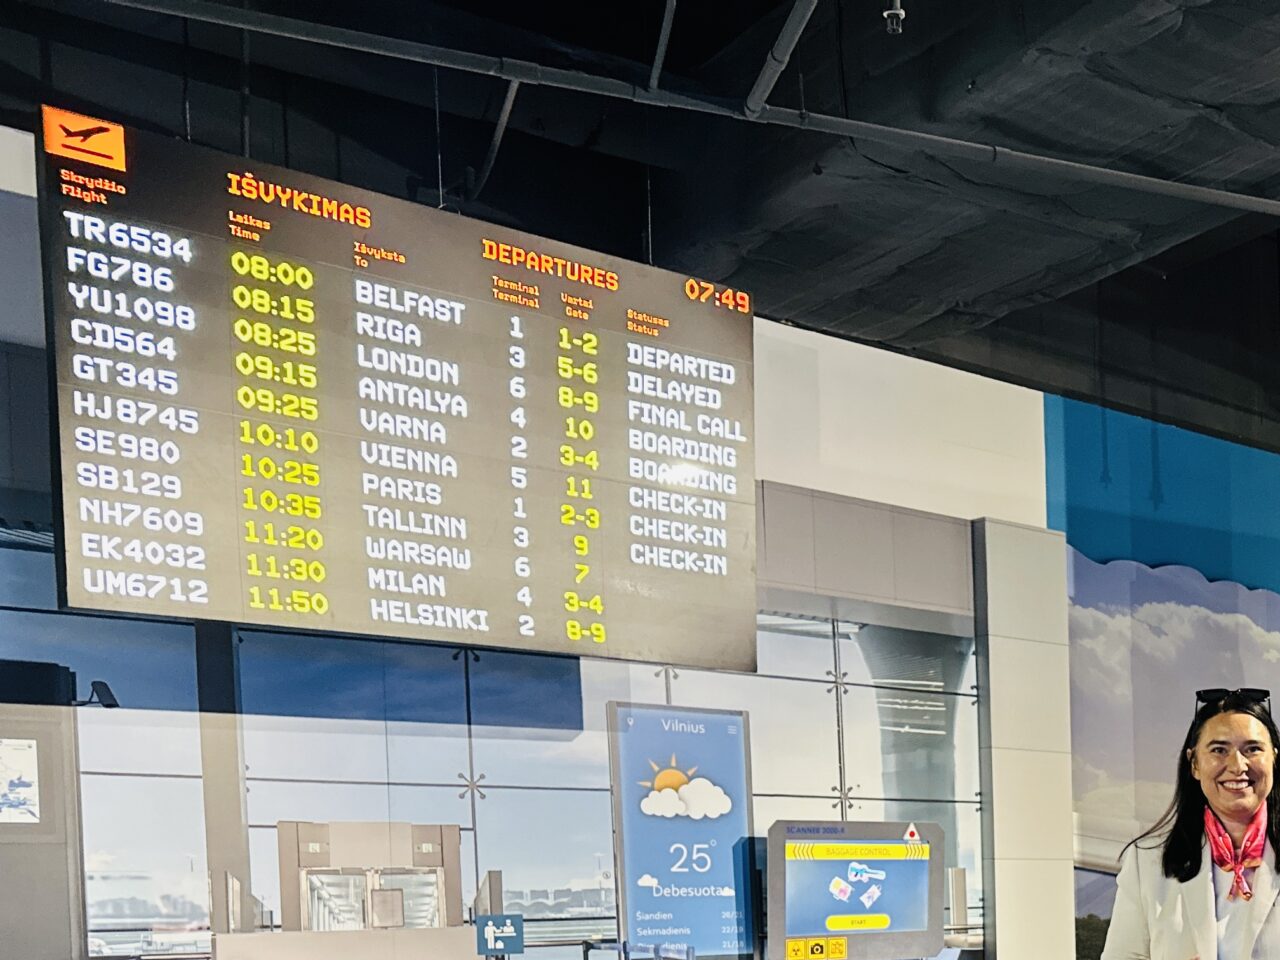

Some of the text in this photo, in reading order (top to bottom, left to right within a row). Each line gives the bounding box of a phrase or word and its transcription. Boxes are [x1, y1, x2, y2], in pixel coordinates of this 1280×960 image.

[61, 168, 126, 195] Skrydžio
[61, 184, 107, 204] Flight
[226, 171, 372, 229] IŠVYKIMAS
[228, 210, 271, 230] Laikas
[228, 225, 260, 242] Time
[353, 255, 369, 269] To
[482, 238, 751, 314] DEPARTURES 07:49
[492, 275, 541, 296] Terminal
[62, 210, 735, 385] TR6534 08:00 BELFAST 1 1-2 DEPARTED
[66, 246, 722, 410] FG786 08:15 RIGA 3 5-6 DELAYED
[492, 288, 541, 309] Terminal
[565, 305, 590, 321] Gate
[627, 321, 659, 337] Status
[68, 281, 748, 443] YU1098 08:25 LONDON 6 8-9 FINAL CALL
[70, 318, 737, 469] CD564 09:15 ANTALYA 4 10 BOARDING
[73, 353, 179, 395] GT345
[237, 385, 318, 422] 09:25
[360, 407, 446, 445] VARNA
[510, 436, 528, 458] 2
[559, 445, 600, 471] 3-4
[72, 390, 726, 521] HJ8745 10:10 VIENNA 5 11 CHECK-IN
[74, 426, 727, 548] SE980 10:25 PARIS 1 2-3 CHECK-IN
[76, 461, 728, 576] SB129 10:35 TALLINN 3 9 CHECK-IN
[79, 497, 590, 584] NH7609 11:20 WARSAW 6 7
[81, 533, 604, 615] EK4032 11:30 MILAN 4 3-4
[82, 567, 606, 644] UM6712 11:50 HELSINKI 2 8-9
[661, 718, 706, 734] Vilnius
[652, 883, 728, 898] Debesuota
